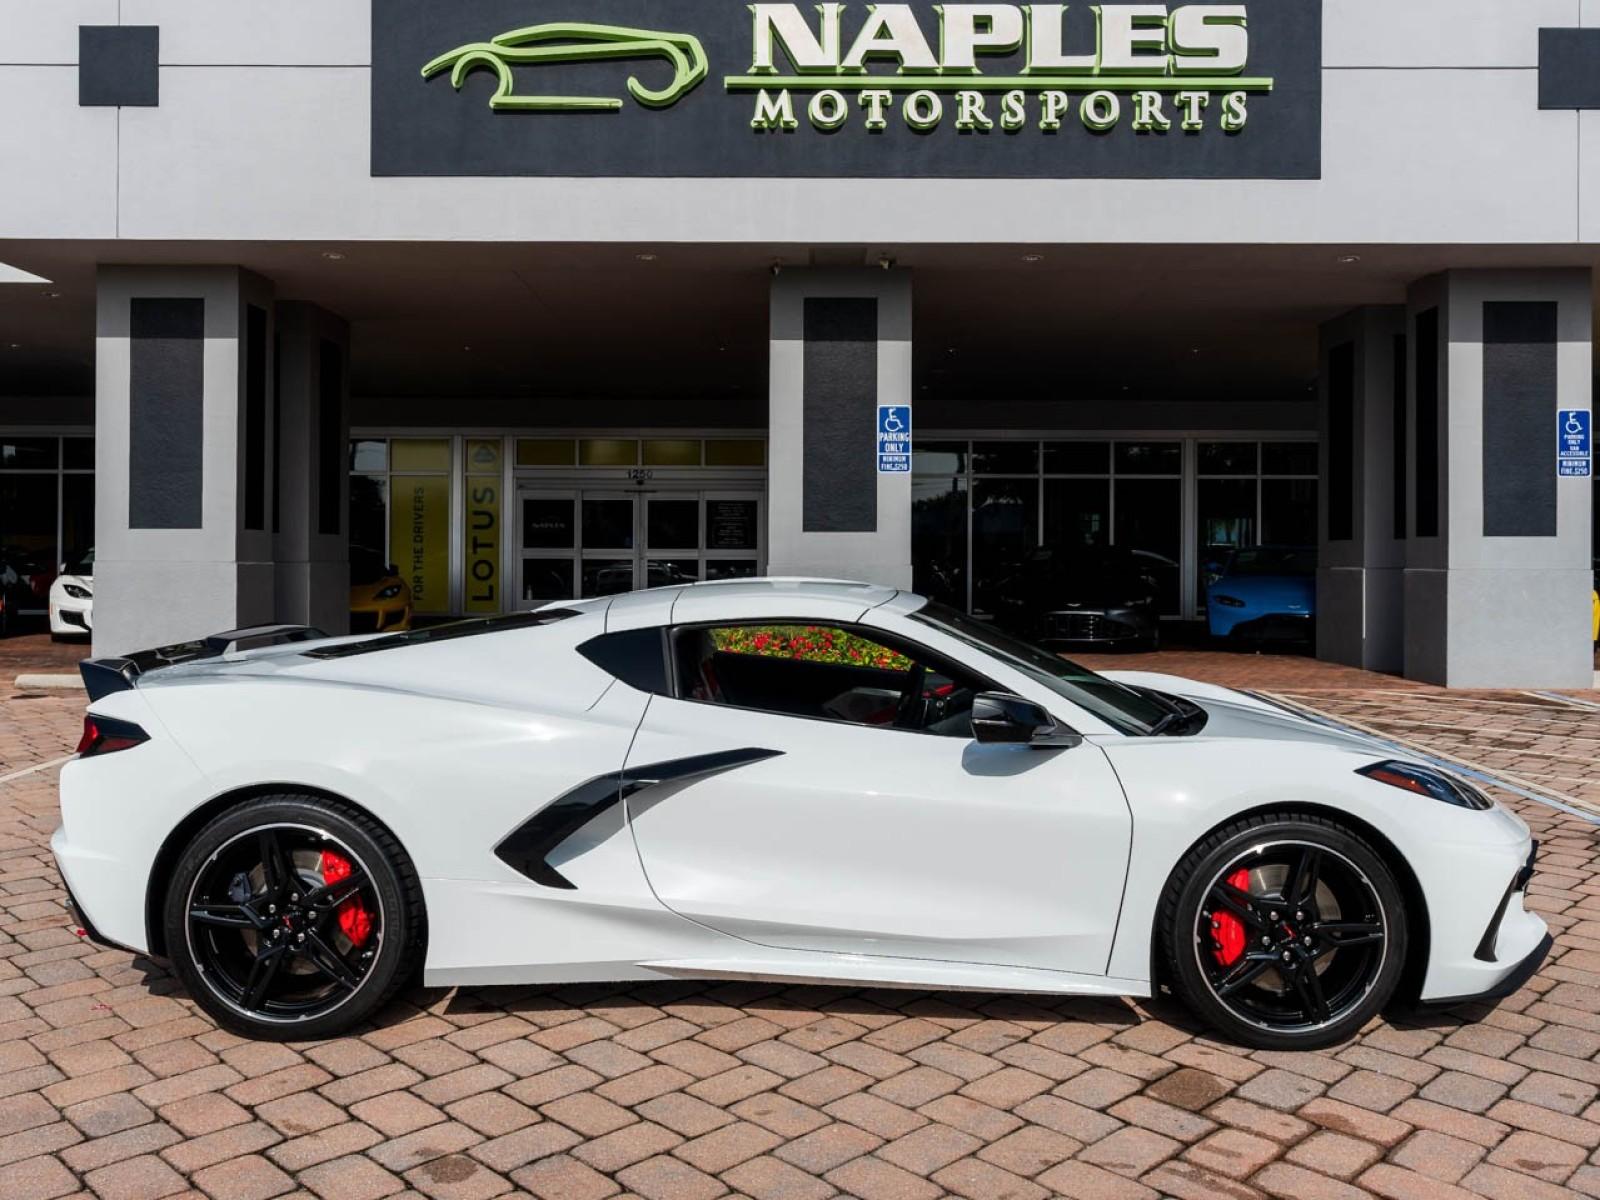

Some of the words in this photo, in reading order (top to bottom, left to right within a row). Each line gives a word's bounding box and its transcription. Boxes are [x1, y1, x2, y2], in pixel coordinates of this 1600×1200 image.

[749, 3, 1249, 75] NAPLES
[751, 89, 1248, 132] MOTORSPORTS
[879, 432, 909, 442] PARKING
[885, 443, 904, 452] ONLY
[413, 487, 425, 544] DRIVERS
[413, 548, 425, 572] THE
[472, 487, 496, 601] LOTUS
[413, 576, 425, 601] FOR
